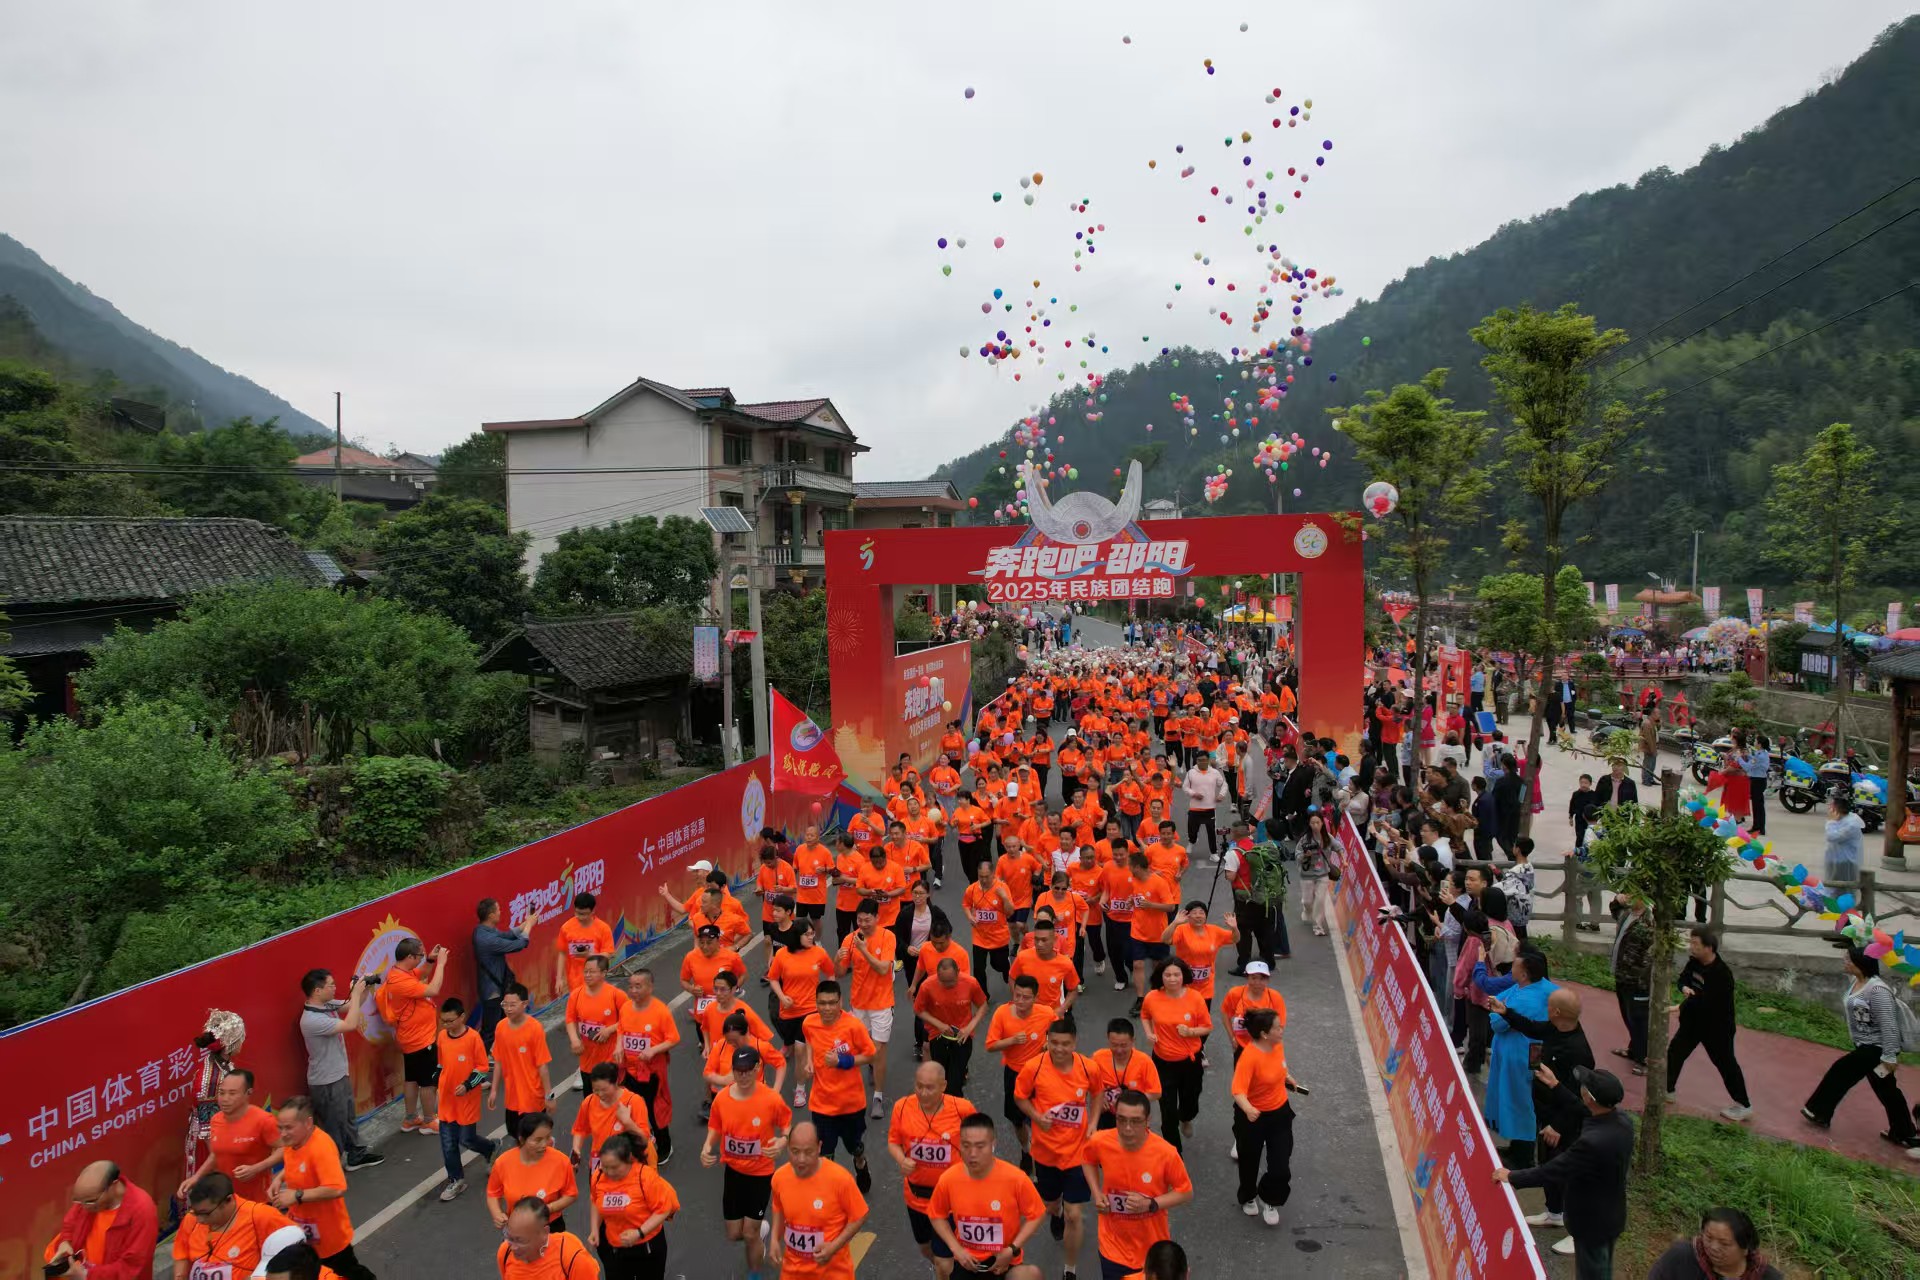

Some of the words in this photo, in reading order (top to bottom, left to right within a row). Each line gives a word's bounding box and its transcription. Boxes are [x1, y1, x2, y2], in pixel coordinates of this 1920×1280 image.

[990, 578, 1172, 600] 2025年民族团结跑
[658, 817, 705, 853] 中国体育彩票
[574, 859, 604, 896] 邵阳
[978, 911, 995, 921] 330
[625, 1037, 647, 1051] 599
[30, 1132, 86, 1168] CHINA
[91, 1099, 156, 1140] SPORTS
[728, 1140, 756, 1155] 657
[915, 1145, 946, 1161] 430
[605, 1194, 624, 1207] 596
[788, 1231, 816, 1250] 441
[962, 1224, 994, 1242] 501
